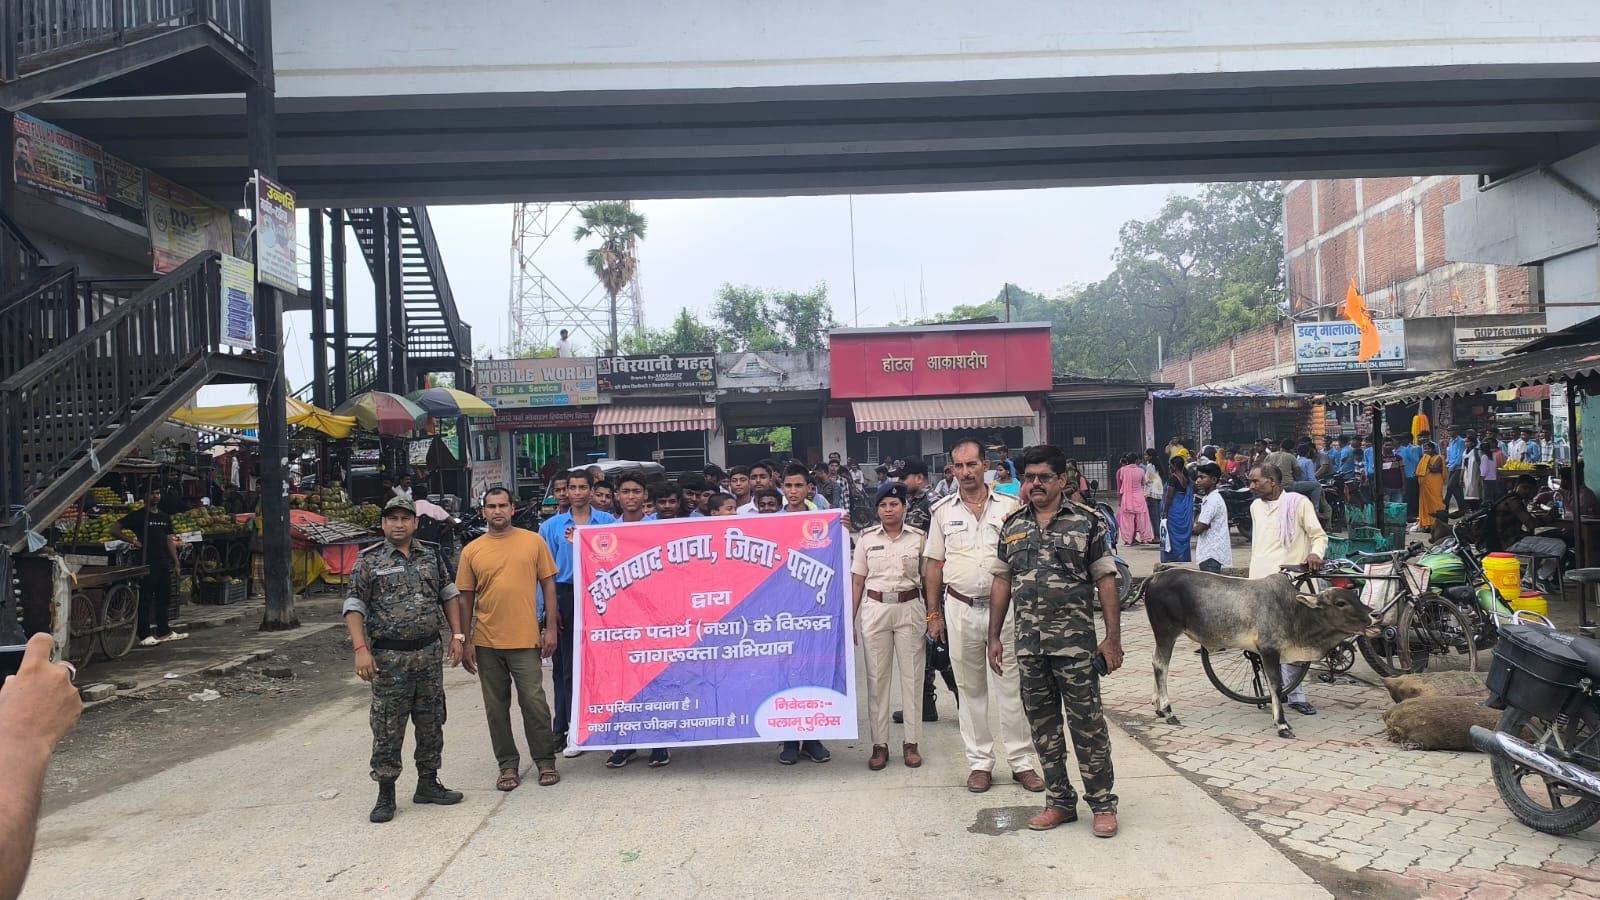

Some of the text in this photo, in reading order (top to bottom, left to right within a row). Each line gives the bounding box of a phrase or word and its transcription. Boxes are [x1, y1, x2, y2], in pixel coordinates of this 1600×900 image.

[1474, 328, 1504, 338] GUPTA
[477, 361, 516, 370] MANISH
[611, 354, 714, 373] बिरयानी महल
[882, 350, 988, 372] होटल आकाशदीप
[477, 365, 595, 384] MOBILE WORLD
[496, 386, 514, 394] Sale
[528, 384, 559, 393] Service
[724, 528, 781, 568] जिला-
[787, 548, 835, 606] पलामू
[691, 590, 732, 609] द्वारा
[591, 627, 642, 643] मादक
[646, 623, 692, 641] पदार्थ
[696, 616, 749, 642] (नशा)
[753, 615, 773, 634] के
[721, 639, 794, 660] अभियान
[588, 703, 604, 715] घर
[605, 699, 643, 714] परिवार
[644, 701, 679, 712] बचाना
[681, 696, 691, 711] है
[587, 722, 611, 733] नशा
[643, 717, 678, 731] जीवन
[679, 716, 726, 729] अपनाना
[727, 712, 736, 727] है
[767, 712, 841, 732] पलामू पुलिस
